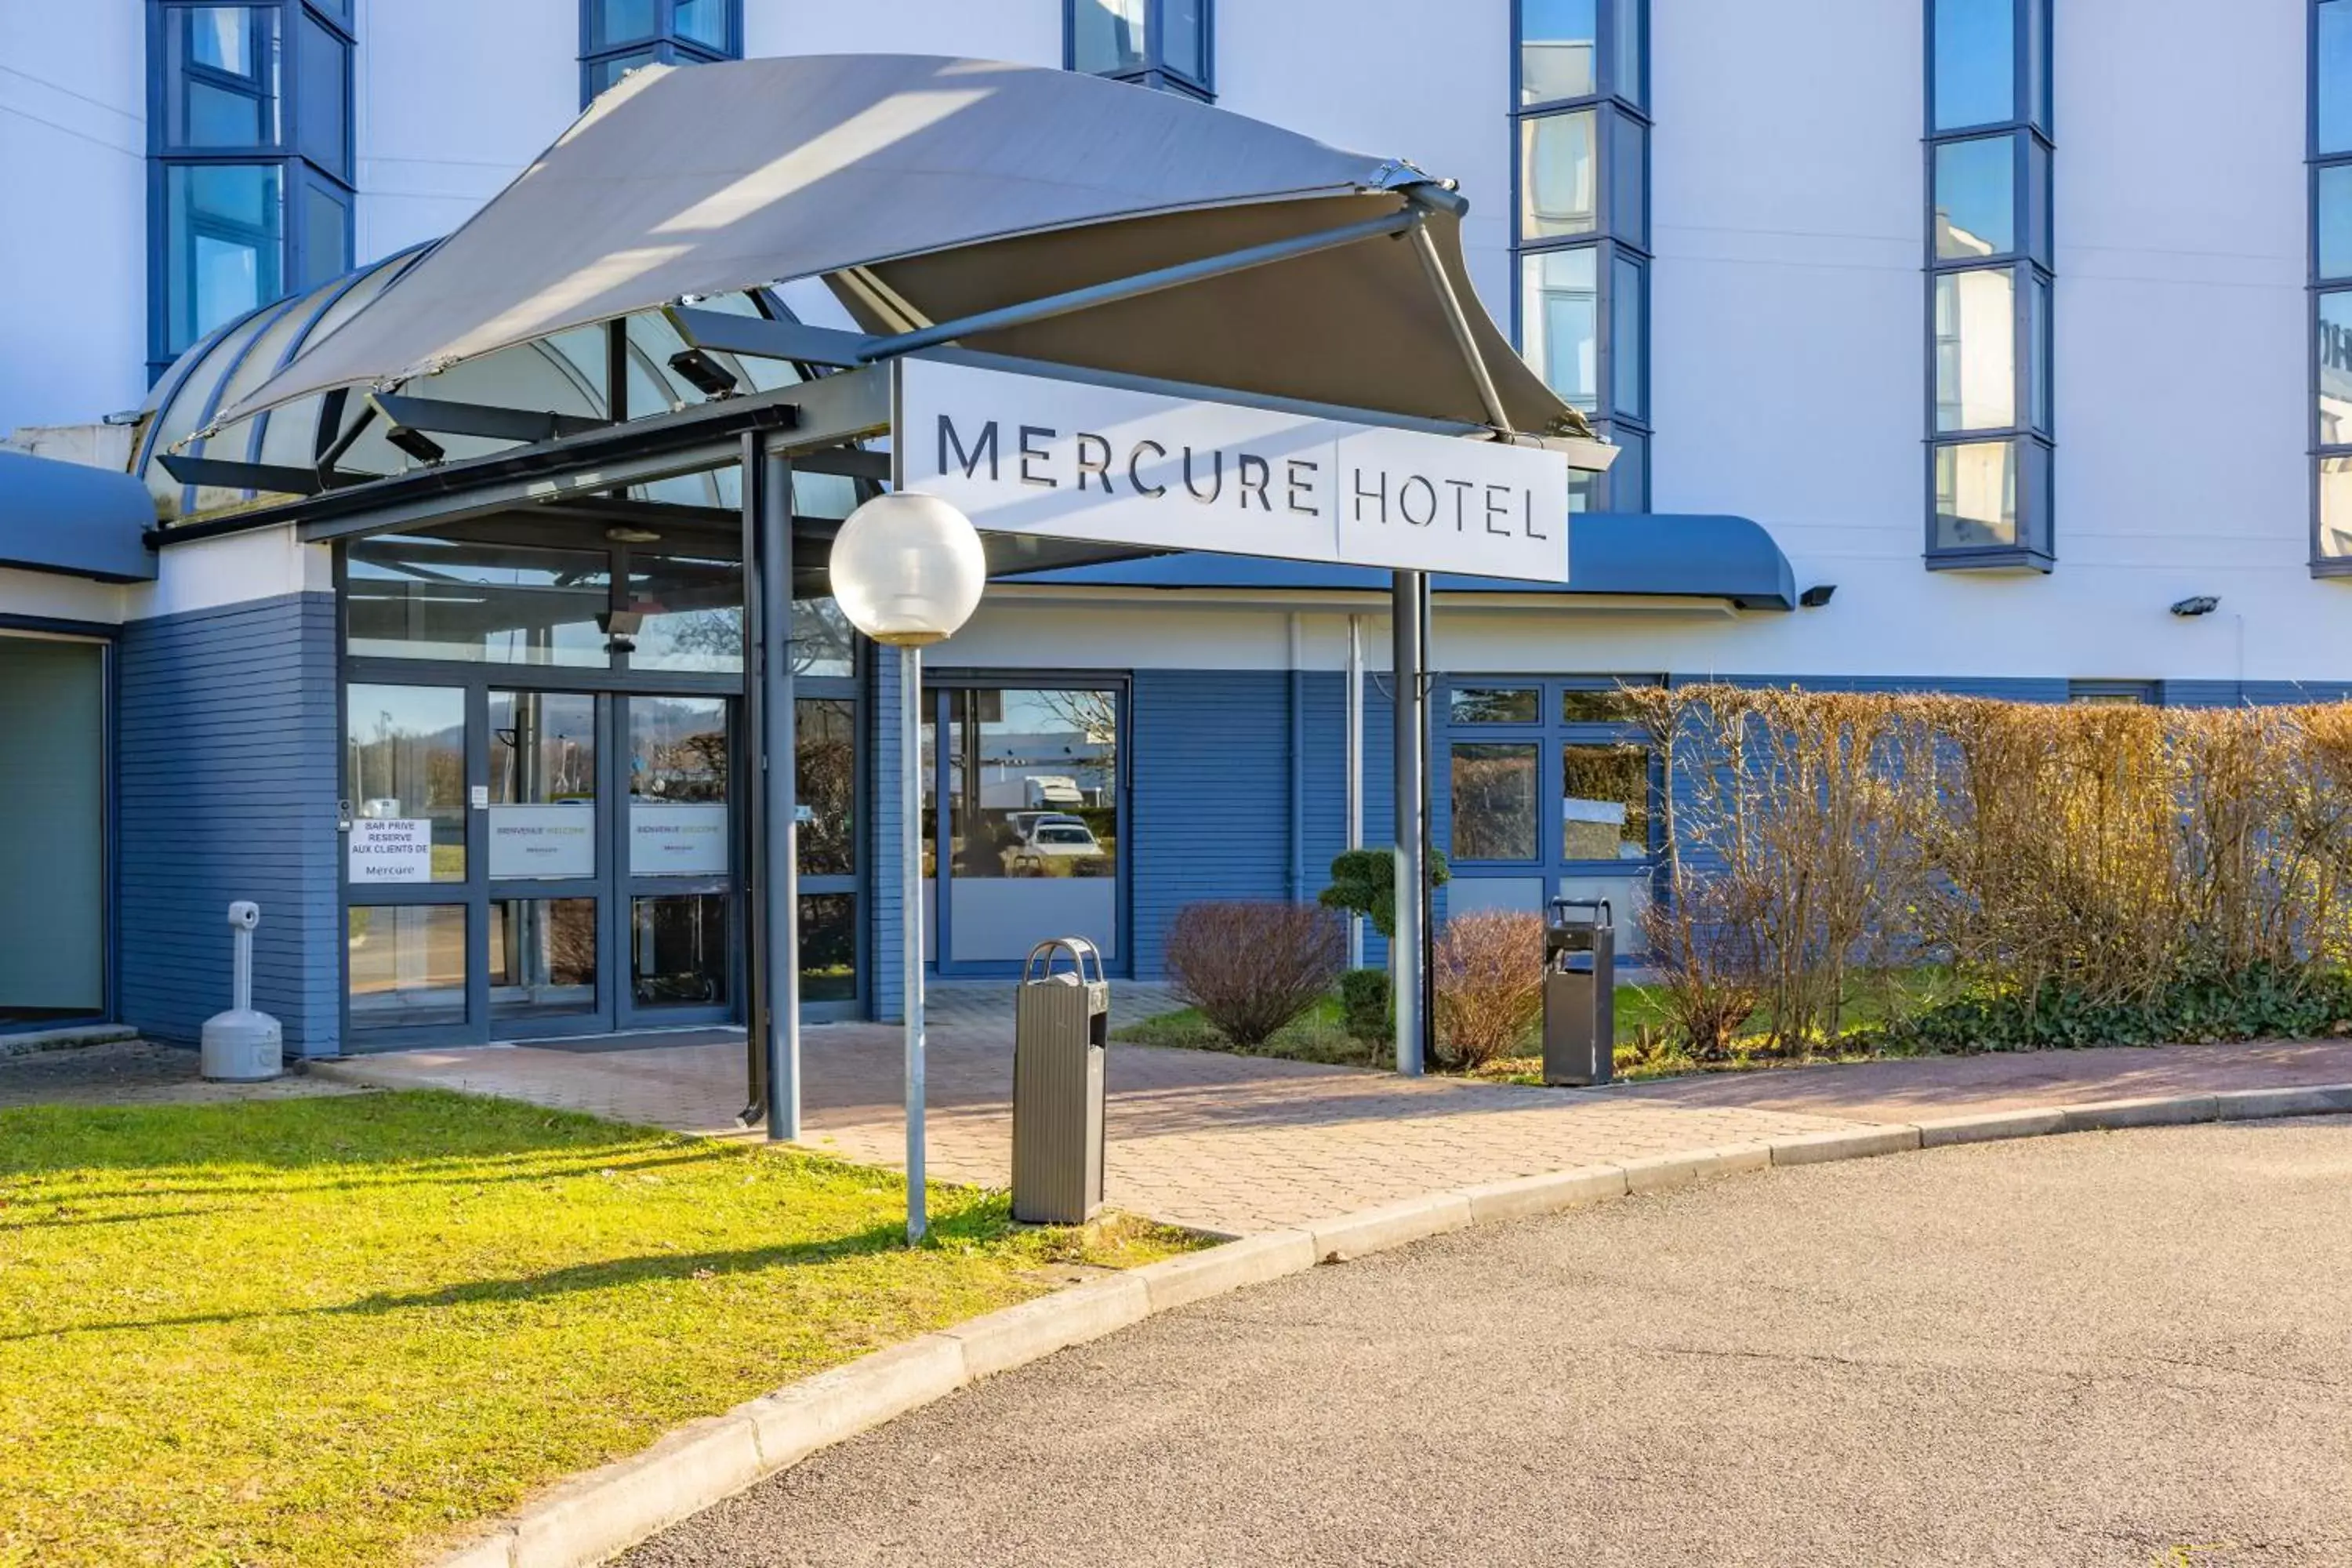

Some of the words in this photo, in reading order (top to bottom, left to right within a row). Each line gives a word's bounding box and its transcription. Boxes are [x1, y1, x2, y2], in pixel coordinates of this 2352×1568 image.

[938, 414, 1319, 516] MERCURE
[1355, 468, 1546, 541] HOTEL
[352, 845, 372, 854] AUX
[374, 845, 413, 854] CLIENTS
[415, 845, 428, 854] DE
[366, 866, 415, 875] Mercure
